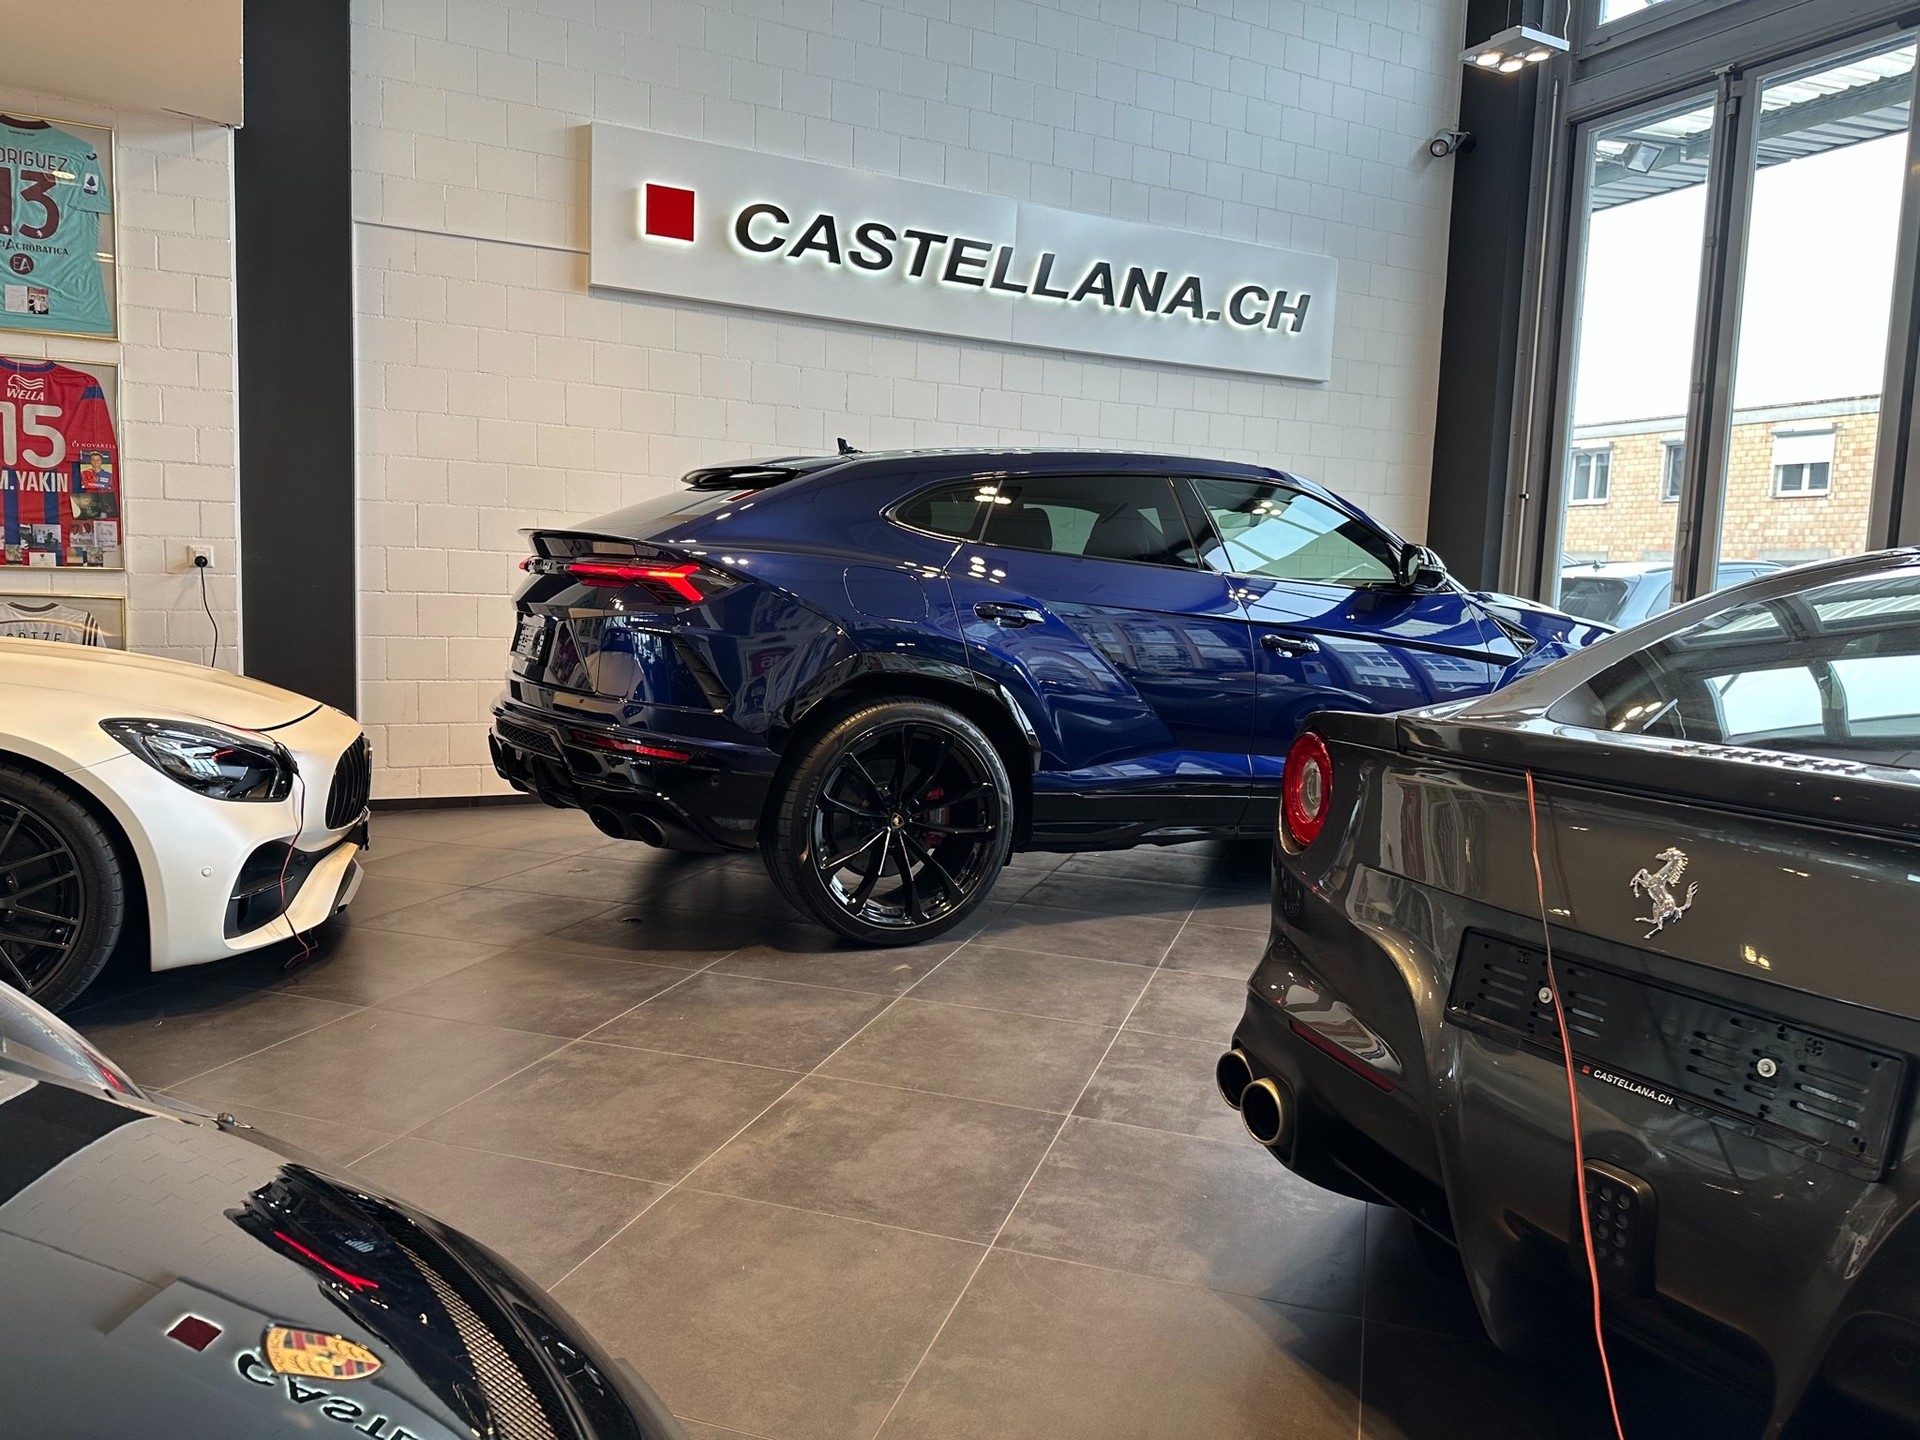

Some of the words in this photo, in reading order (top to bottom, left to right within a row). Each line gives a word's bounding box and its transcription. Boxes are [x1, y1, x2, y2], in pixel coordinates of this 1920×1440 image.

[735, 203, 1311, 333] CASTELLANA.CH
[6, 387, 45, 402] WELLA
[0, 401, 67, 469] 15
[1593, 1069, 1675, 1106] CASTELLANA.CH
